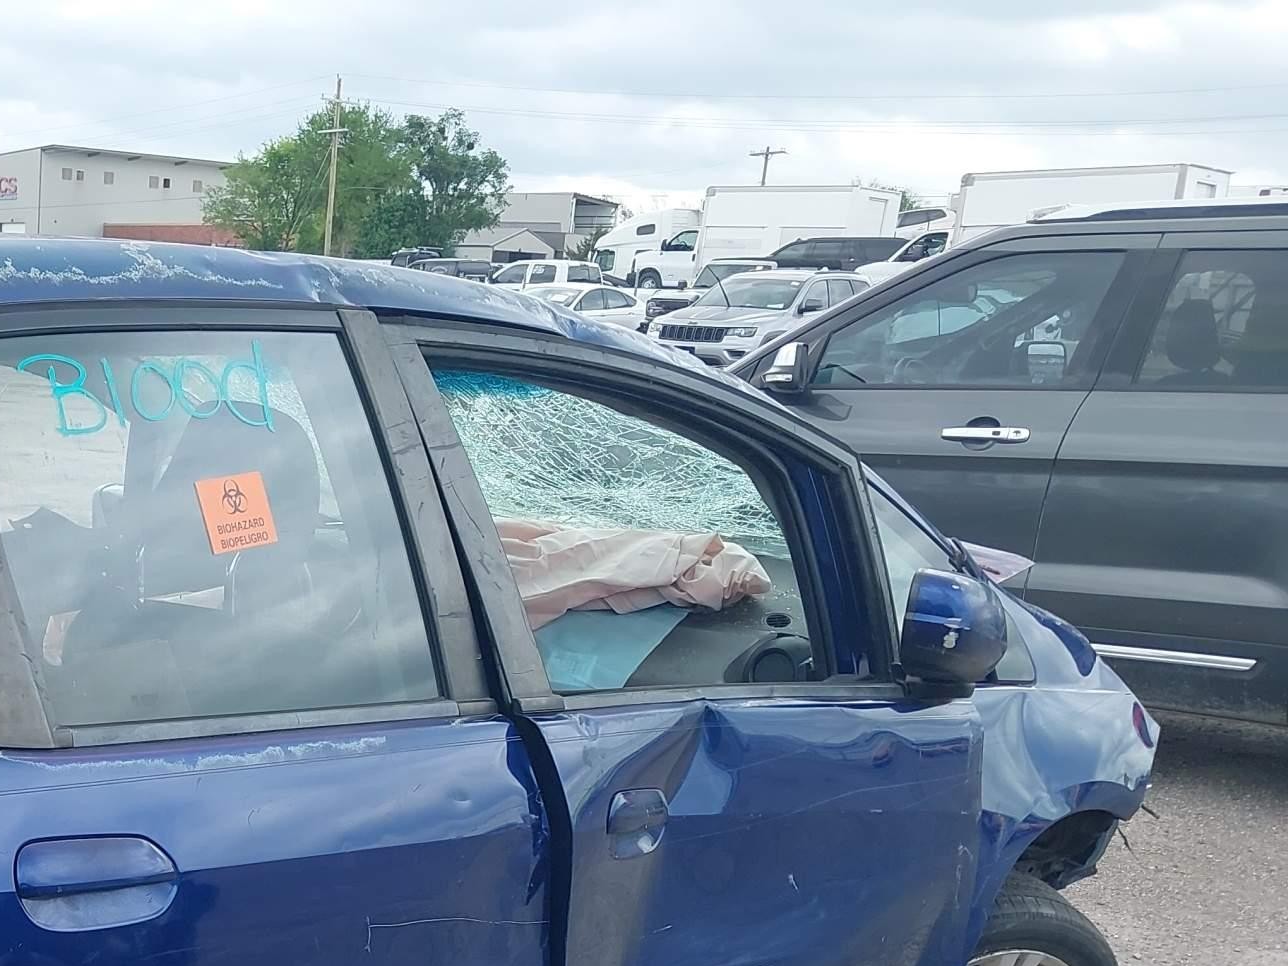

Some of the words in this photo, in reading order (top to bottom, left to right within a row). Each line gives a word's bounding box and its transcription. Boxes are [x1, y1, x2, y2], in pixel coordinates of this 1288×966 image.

[16, 338, 276, 437] Blood
[217, 517, 265, 535] BIOHAZARD
[220, 531, 269, 549] BIOPELIGRO
